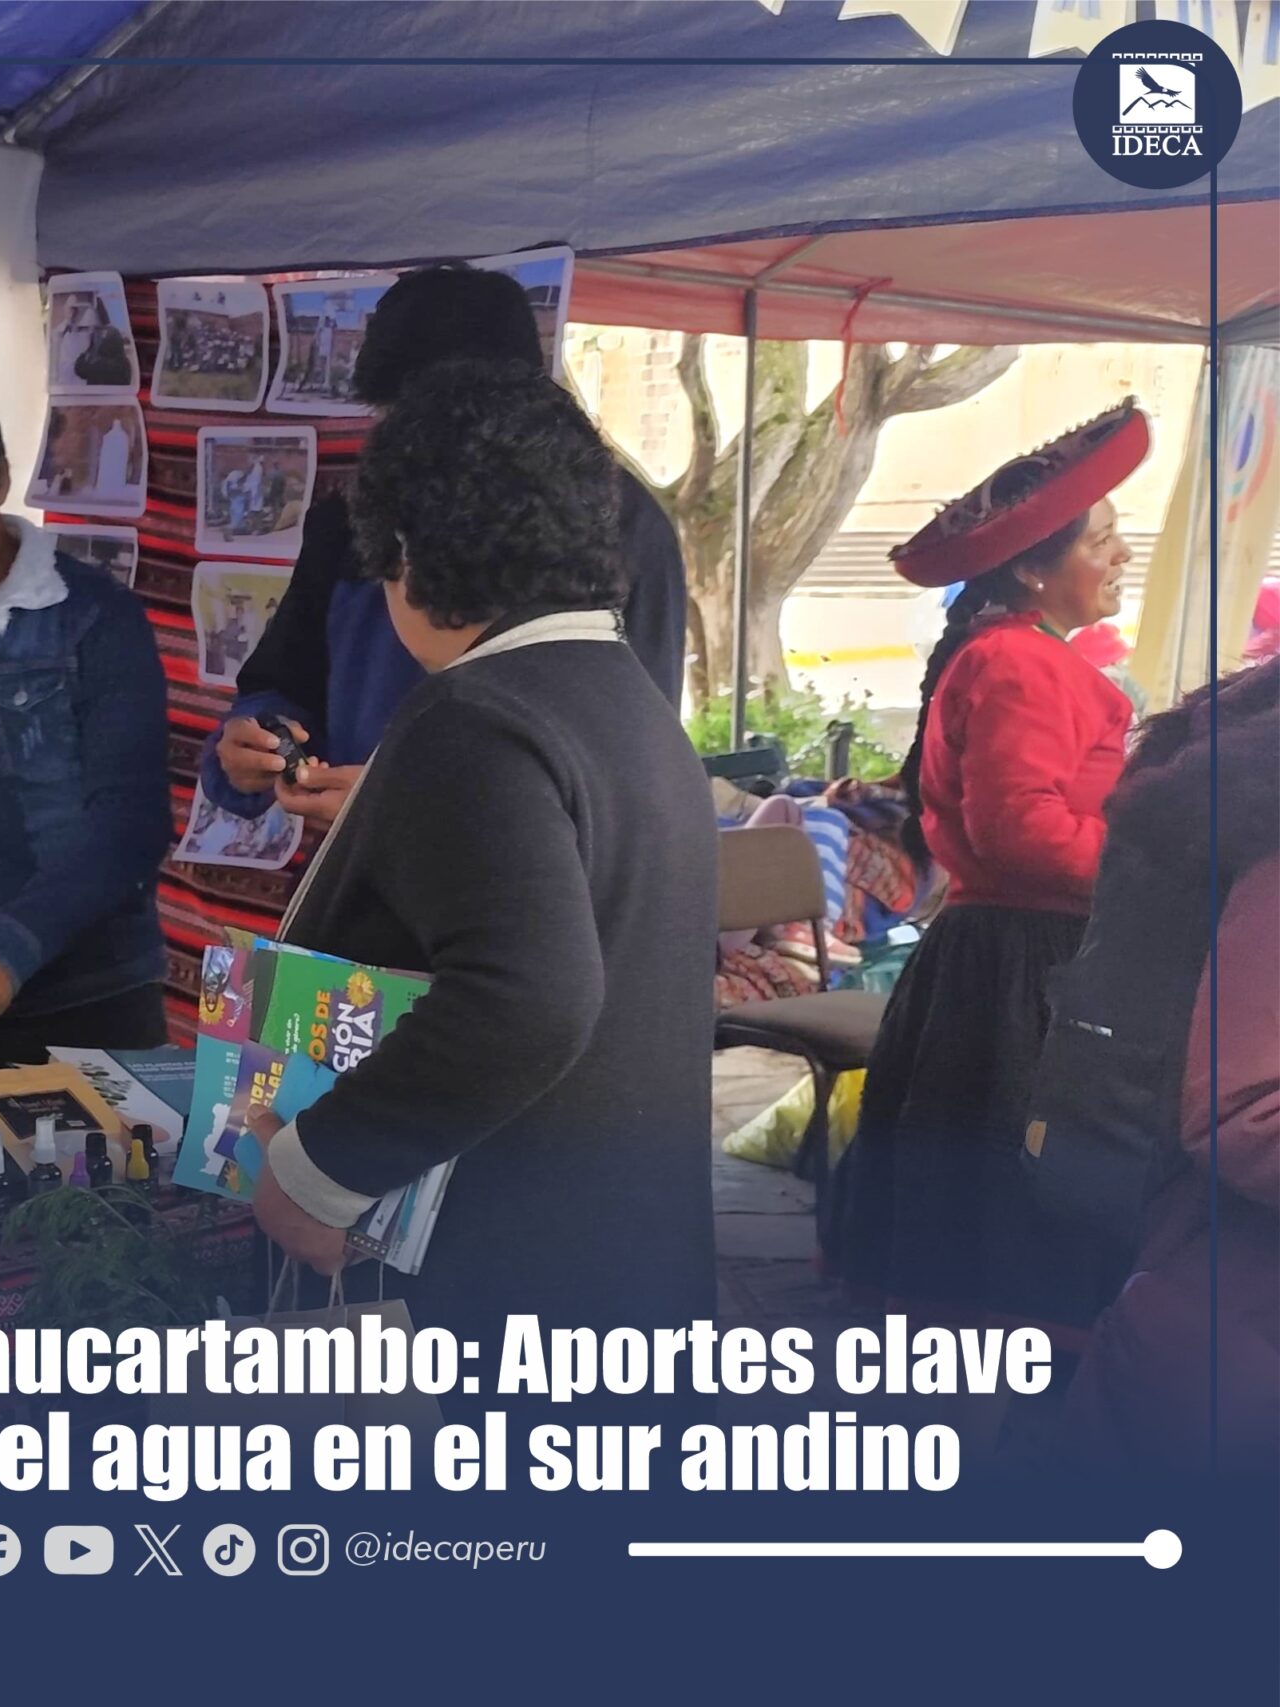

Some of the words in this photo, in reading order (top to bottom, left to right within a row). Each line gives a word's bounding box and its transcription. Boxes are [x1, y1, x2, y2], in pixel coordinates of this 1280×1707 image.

[308, 1023, 328, 1062] OS
[332, 1002, 356, 1073] CIÓN
[350, 1010, 376, 1068] RIA
